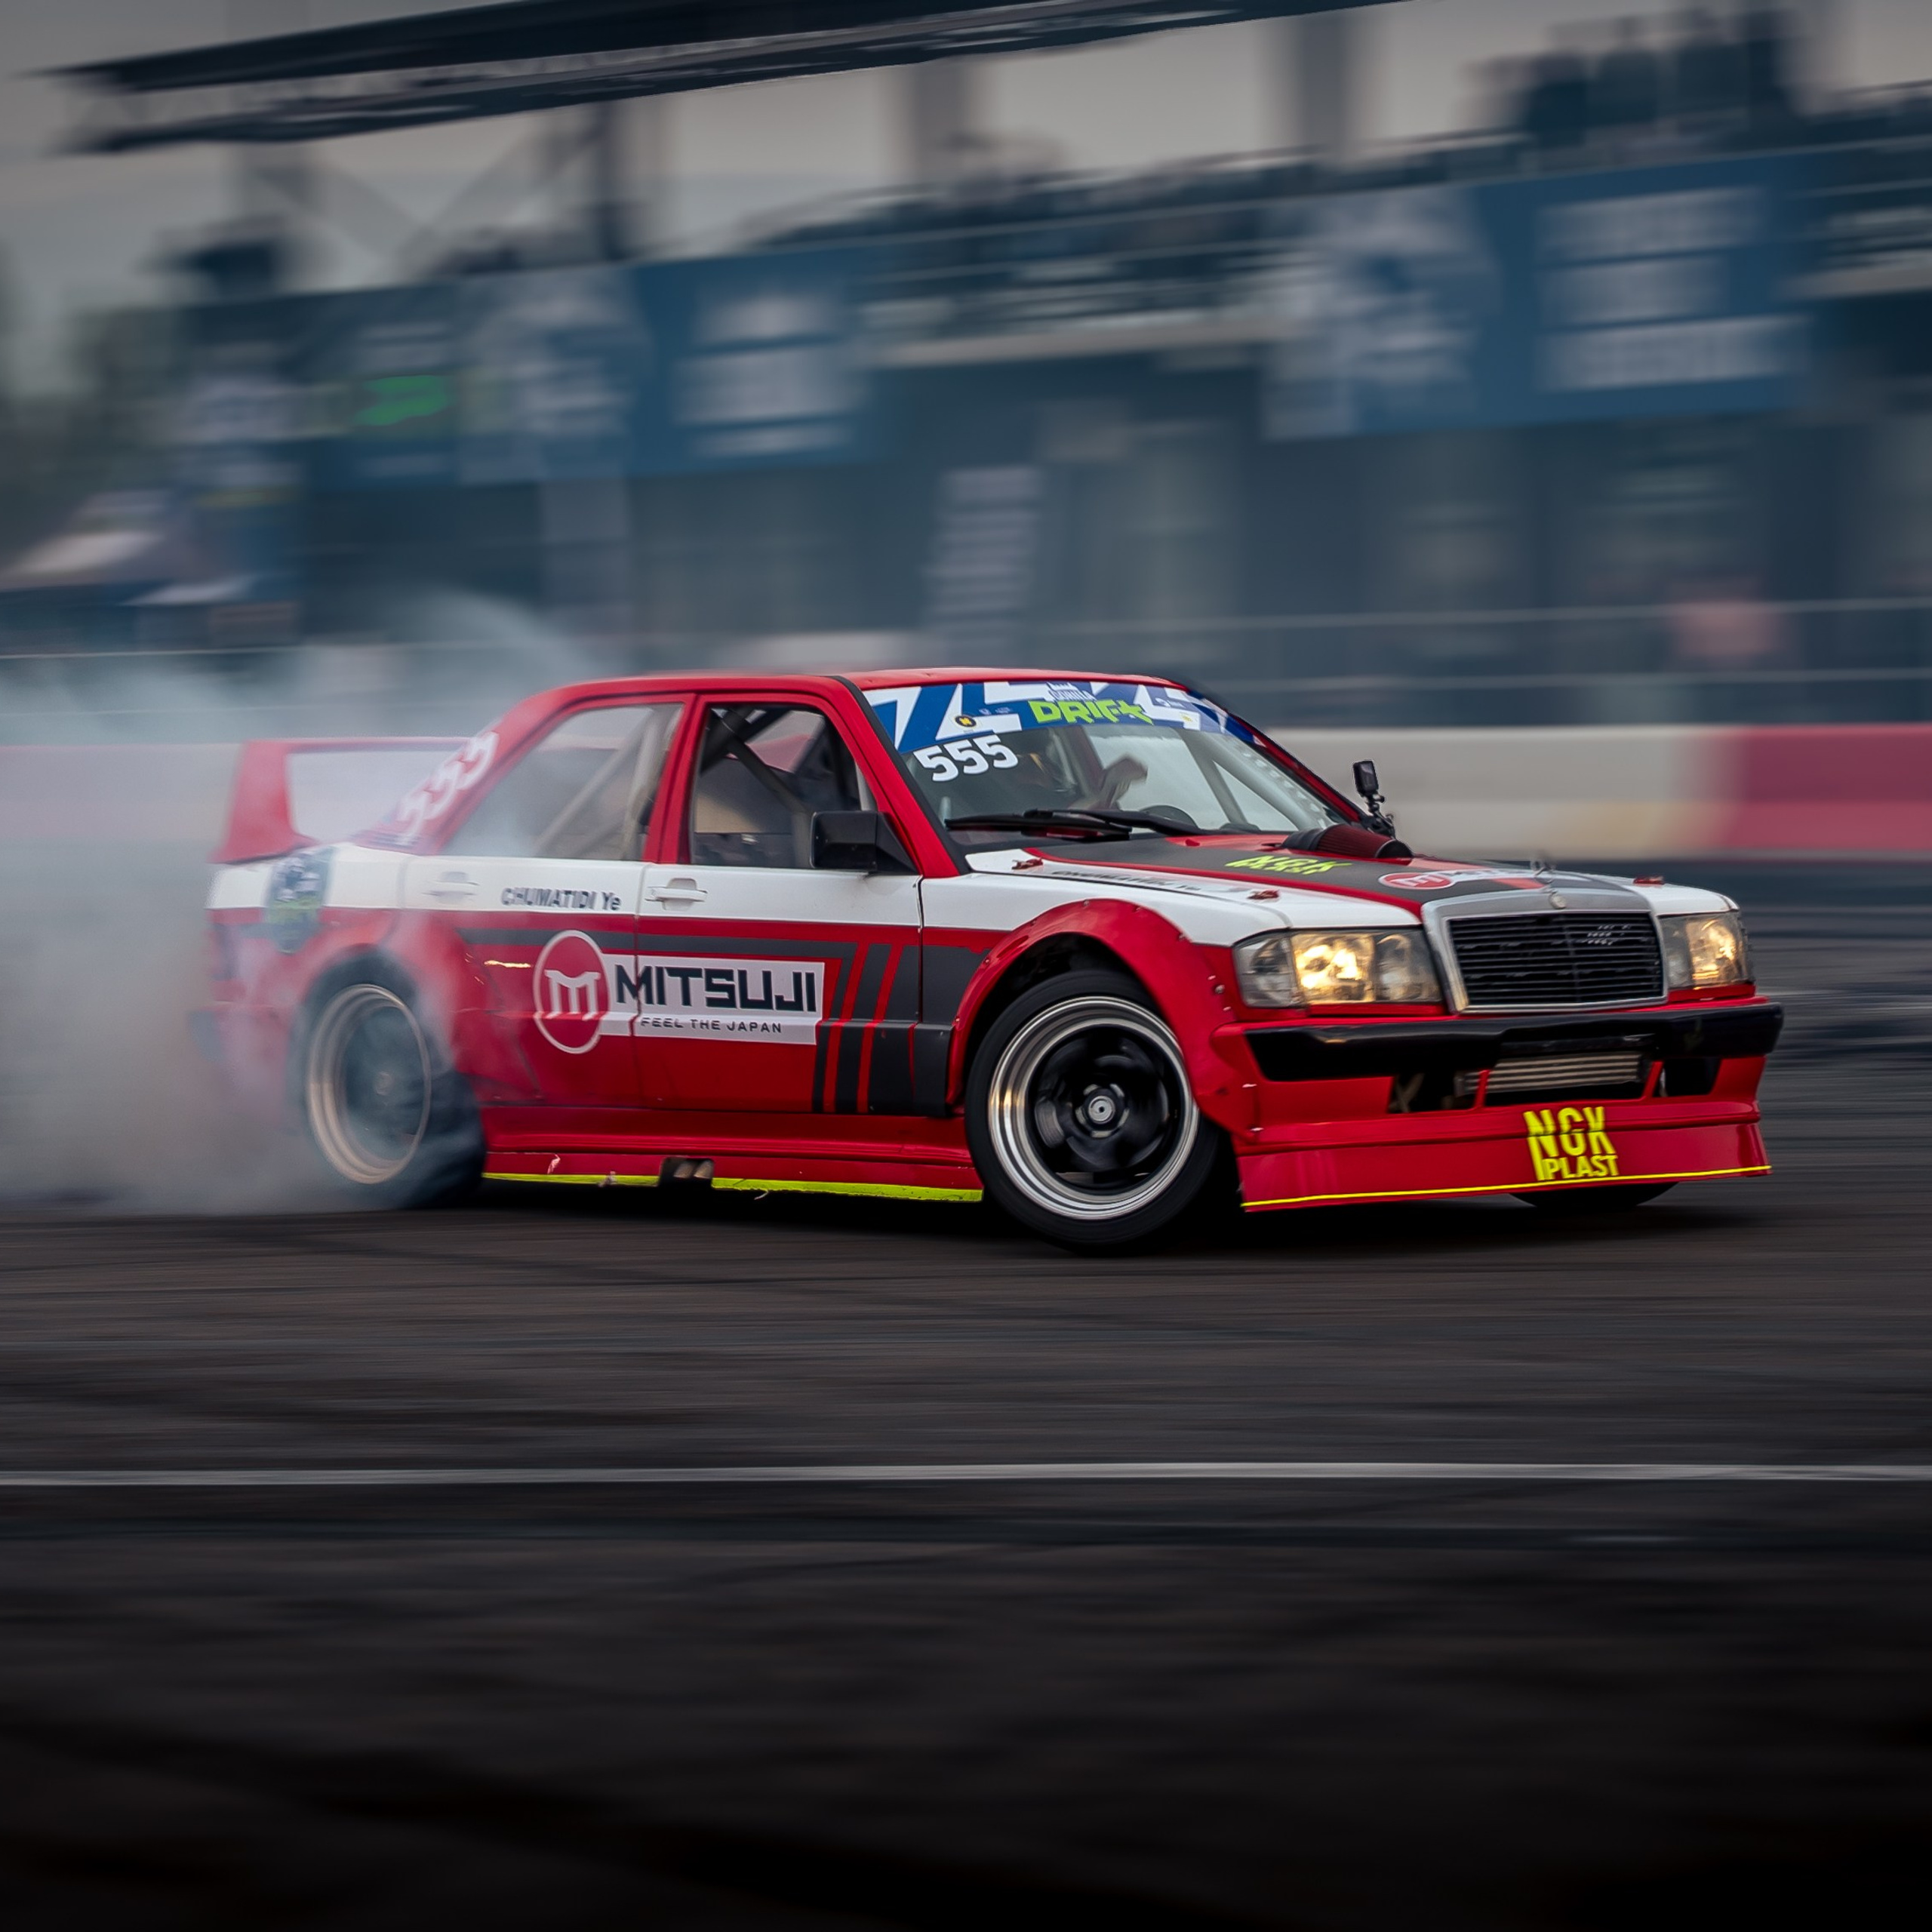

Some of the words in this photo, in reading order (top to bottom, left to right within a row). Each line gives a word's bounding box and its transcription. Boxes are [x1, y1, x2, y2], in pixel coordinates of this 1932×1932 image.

[1028, 699, 1153, 725] DRIFT
[912, 734, 1019, 782] 555
[614, 964, 817, 1013] MITSUJI
[641, 1017, 684, 1029] FEEL
[691, 1019, 721, 1031] THE
[727, 1021, 782, 1033] JAPAN
[1523, 1106, 1616, 1180] NGK
[1543, 1155, 1619, 1180] PLAST
